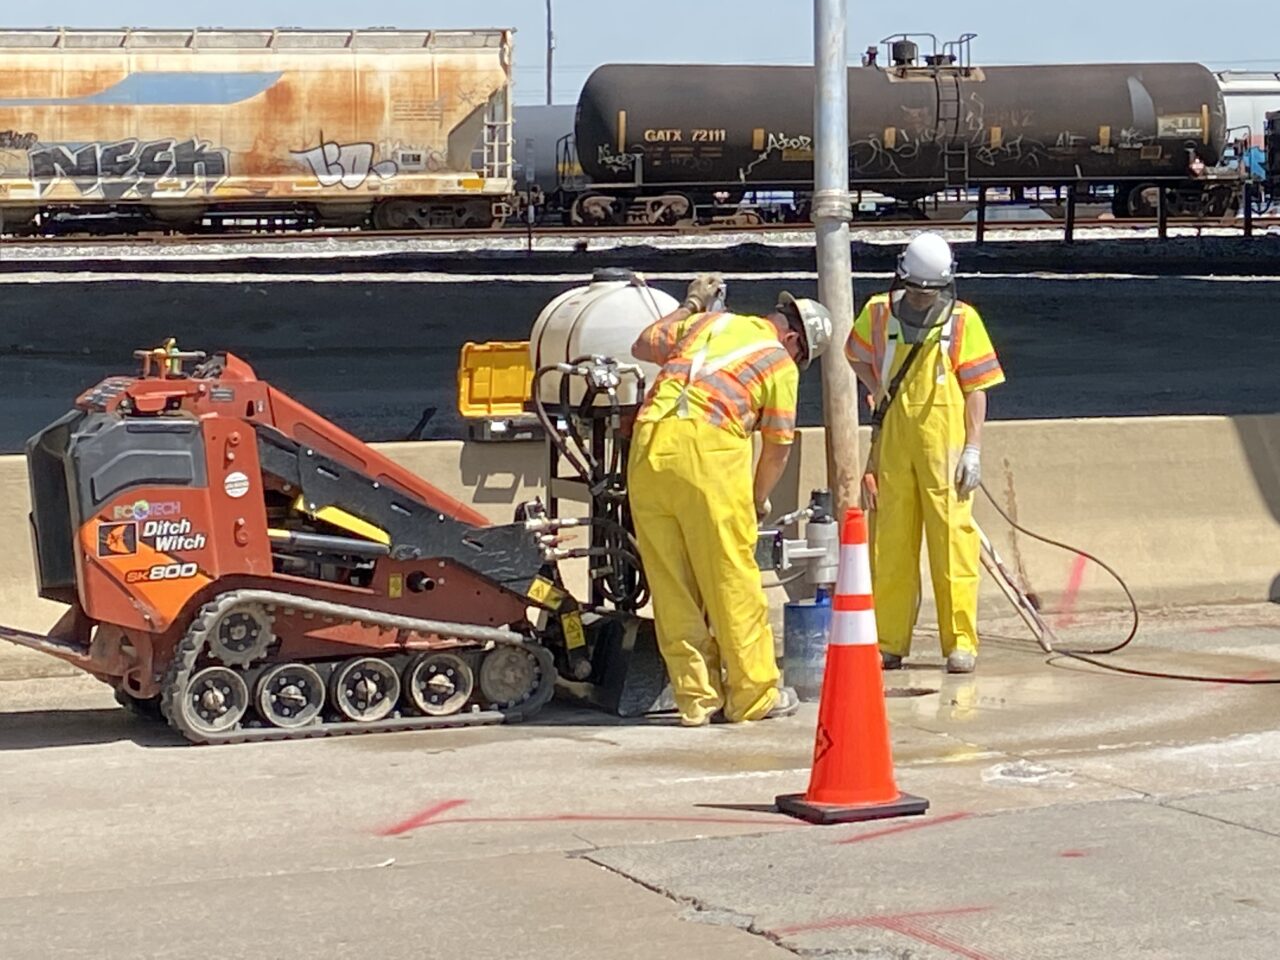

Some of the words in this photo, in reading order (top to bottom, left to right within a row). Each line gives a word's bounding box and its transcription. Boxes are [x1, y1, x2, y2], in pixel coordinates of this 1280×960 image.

[644, 129, 682, 142] GATX
[691, 129, 726, 142] 72111
[143, 518, 191, 538] Ditch
[155, 534, 206, 552] Witch
